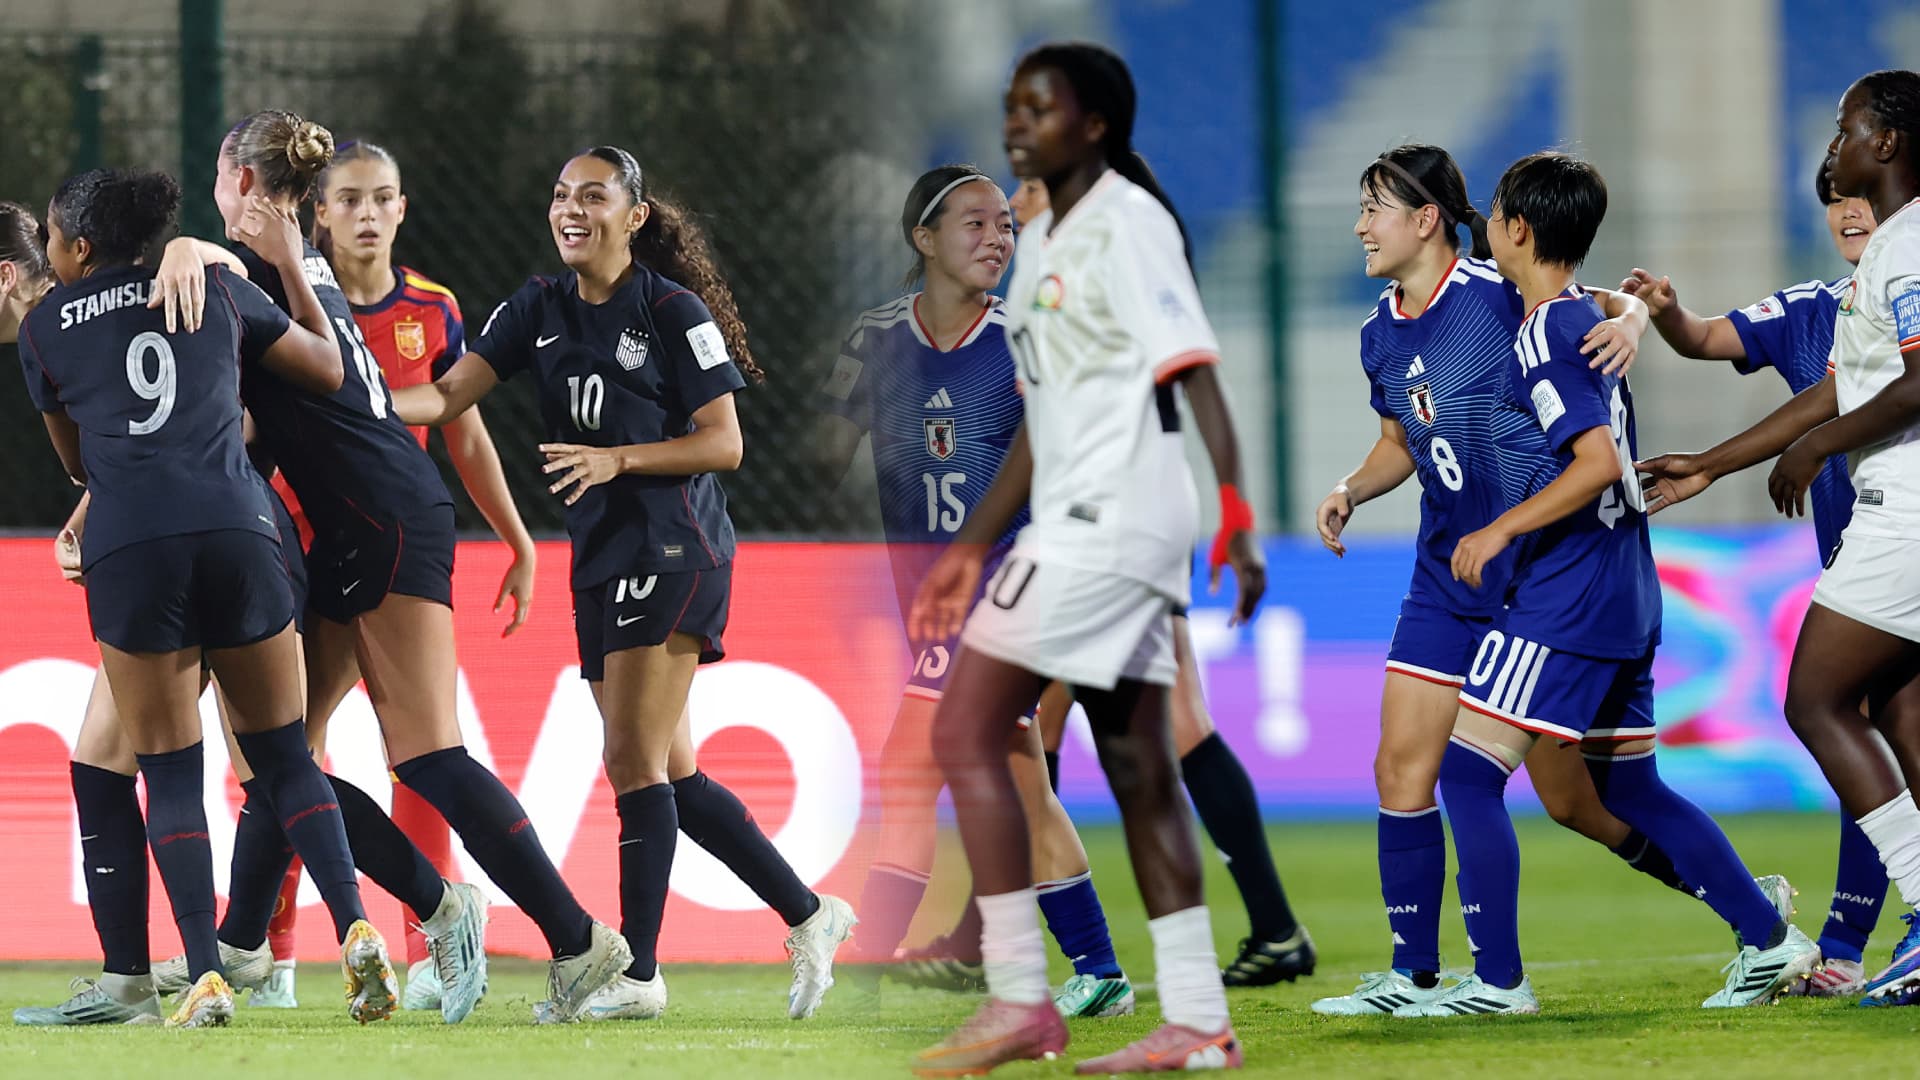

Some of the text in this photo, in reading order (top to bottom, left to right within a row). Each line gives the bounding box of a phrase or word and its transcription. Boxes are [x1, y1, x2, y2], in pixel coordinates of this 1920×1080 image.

[621, 335, 646, 352] USA
[126, 331, 177, 435] 9
[567, 374, 605, 432] 10
[1431, 436, 1464, 492] 8
[922, 472, 967, 532] 15
